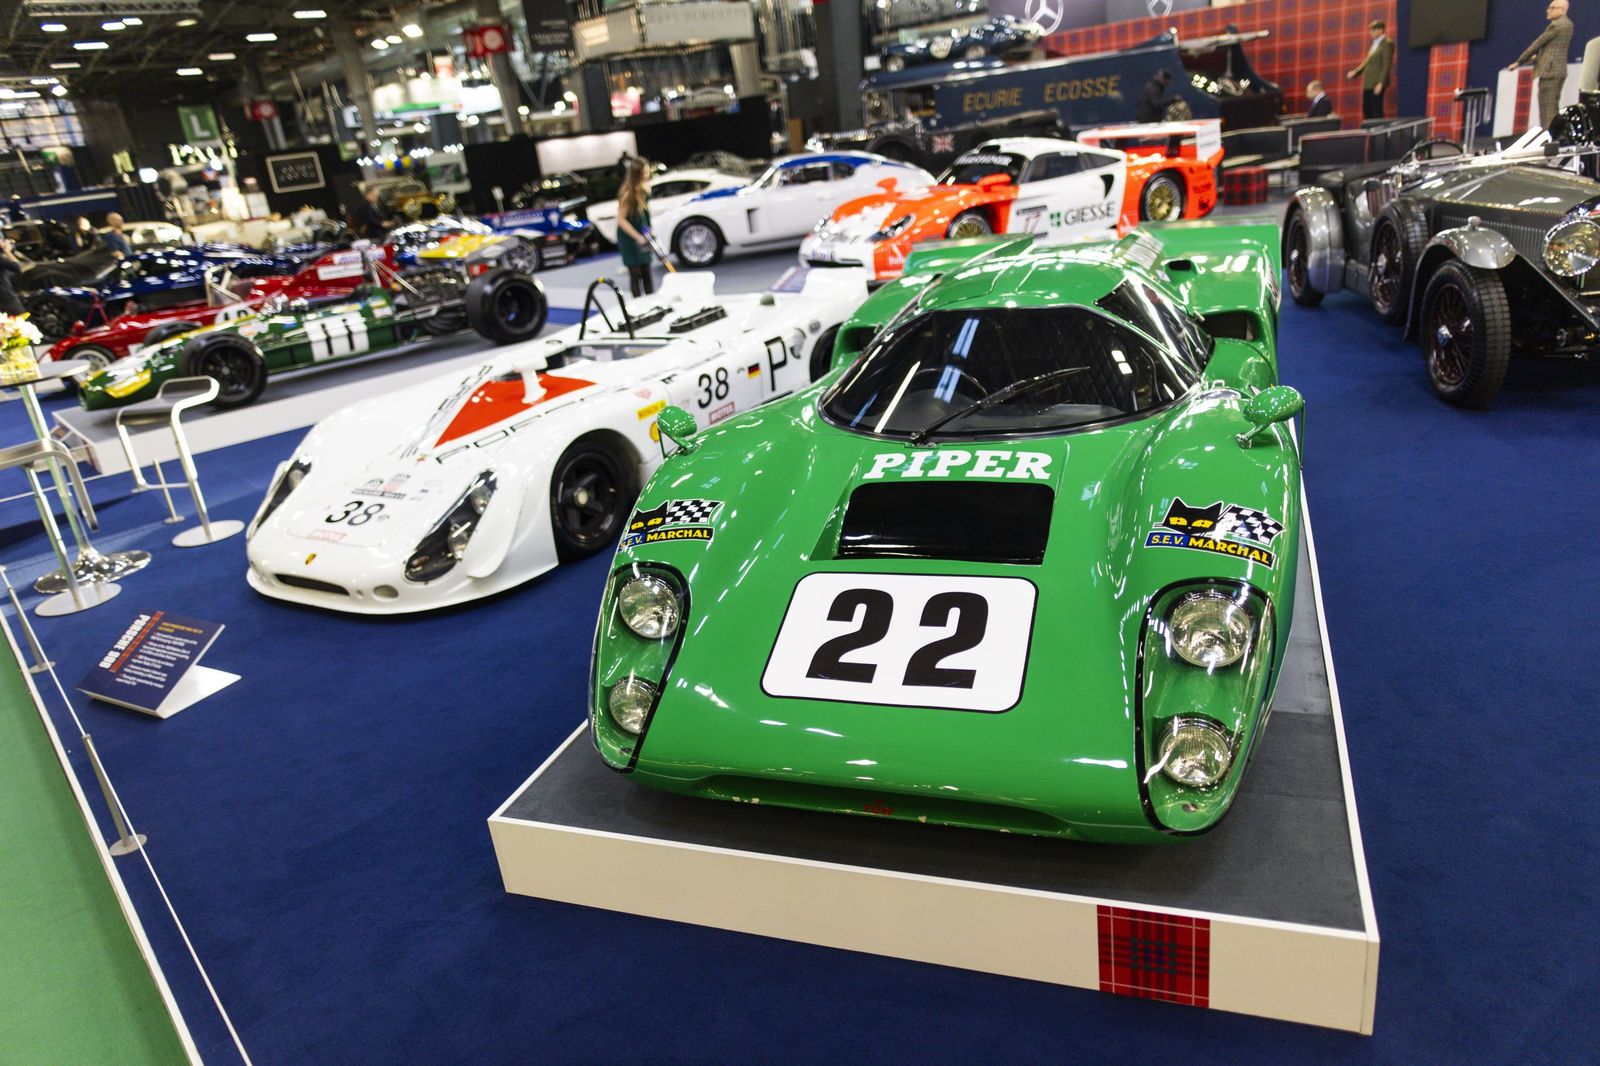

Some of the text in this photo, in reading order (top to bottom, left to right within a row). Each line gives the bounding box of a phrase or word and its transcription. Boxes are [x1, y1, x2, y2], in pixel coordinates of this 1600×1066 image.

[963, 75, 1121, 112] ECURIE ECOSSE
[190, 115, 211, 138] L
[1064, 201, 1115, 225] GIESSE
[320, 318, 356, 356] 11
[698, 367, 729, 408] 38
[863, 450, 1052, 479] PIPER
[325, 501, 385, 526] 38
[646, 529, 710, 542] MARCHAL
[1151, 534, 1270, 564] S.E.V. MARCHAL
[805, 588, 989, 689] 22
